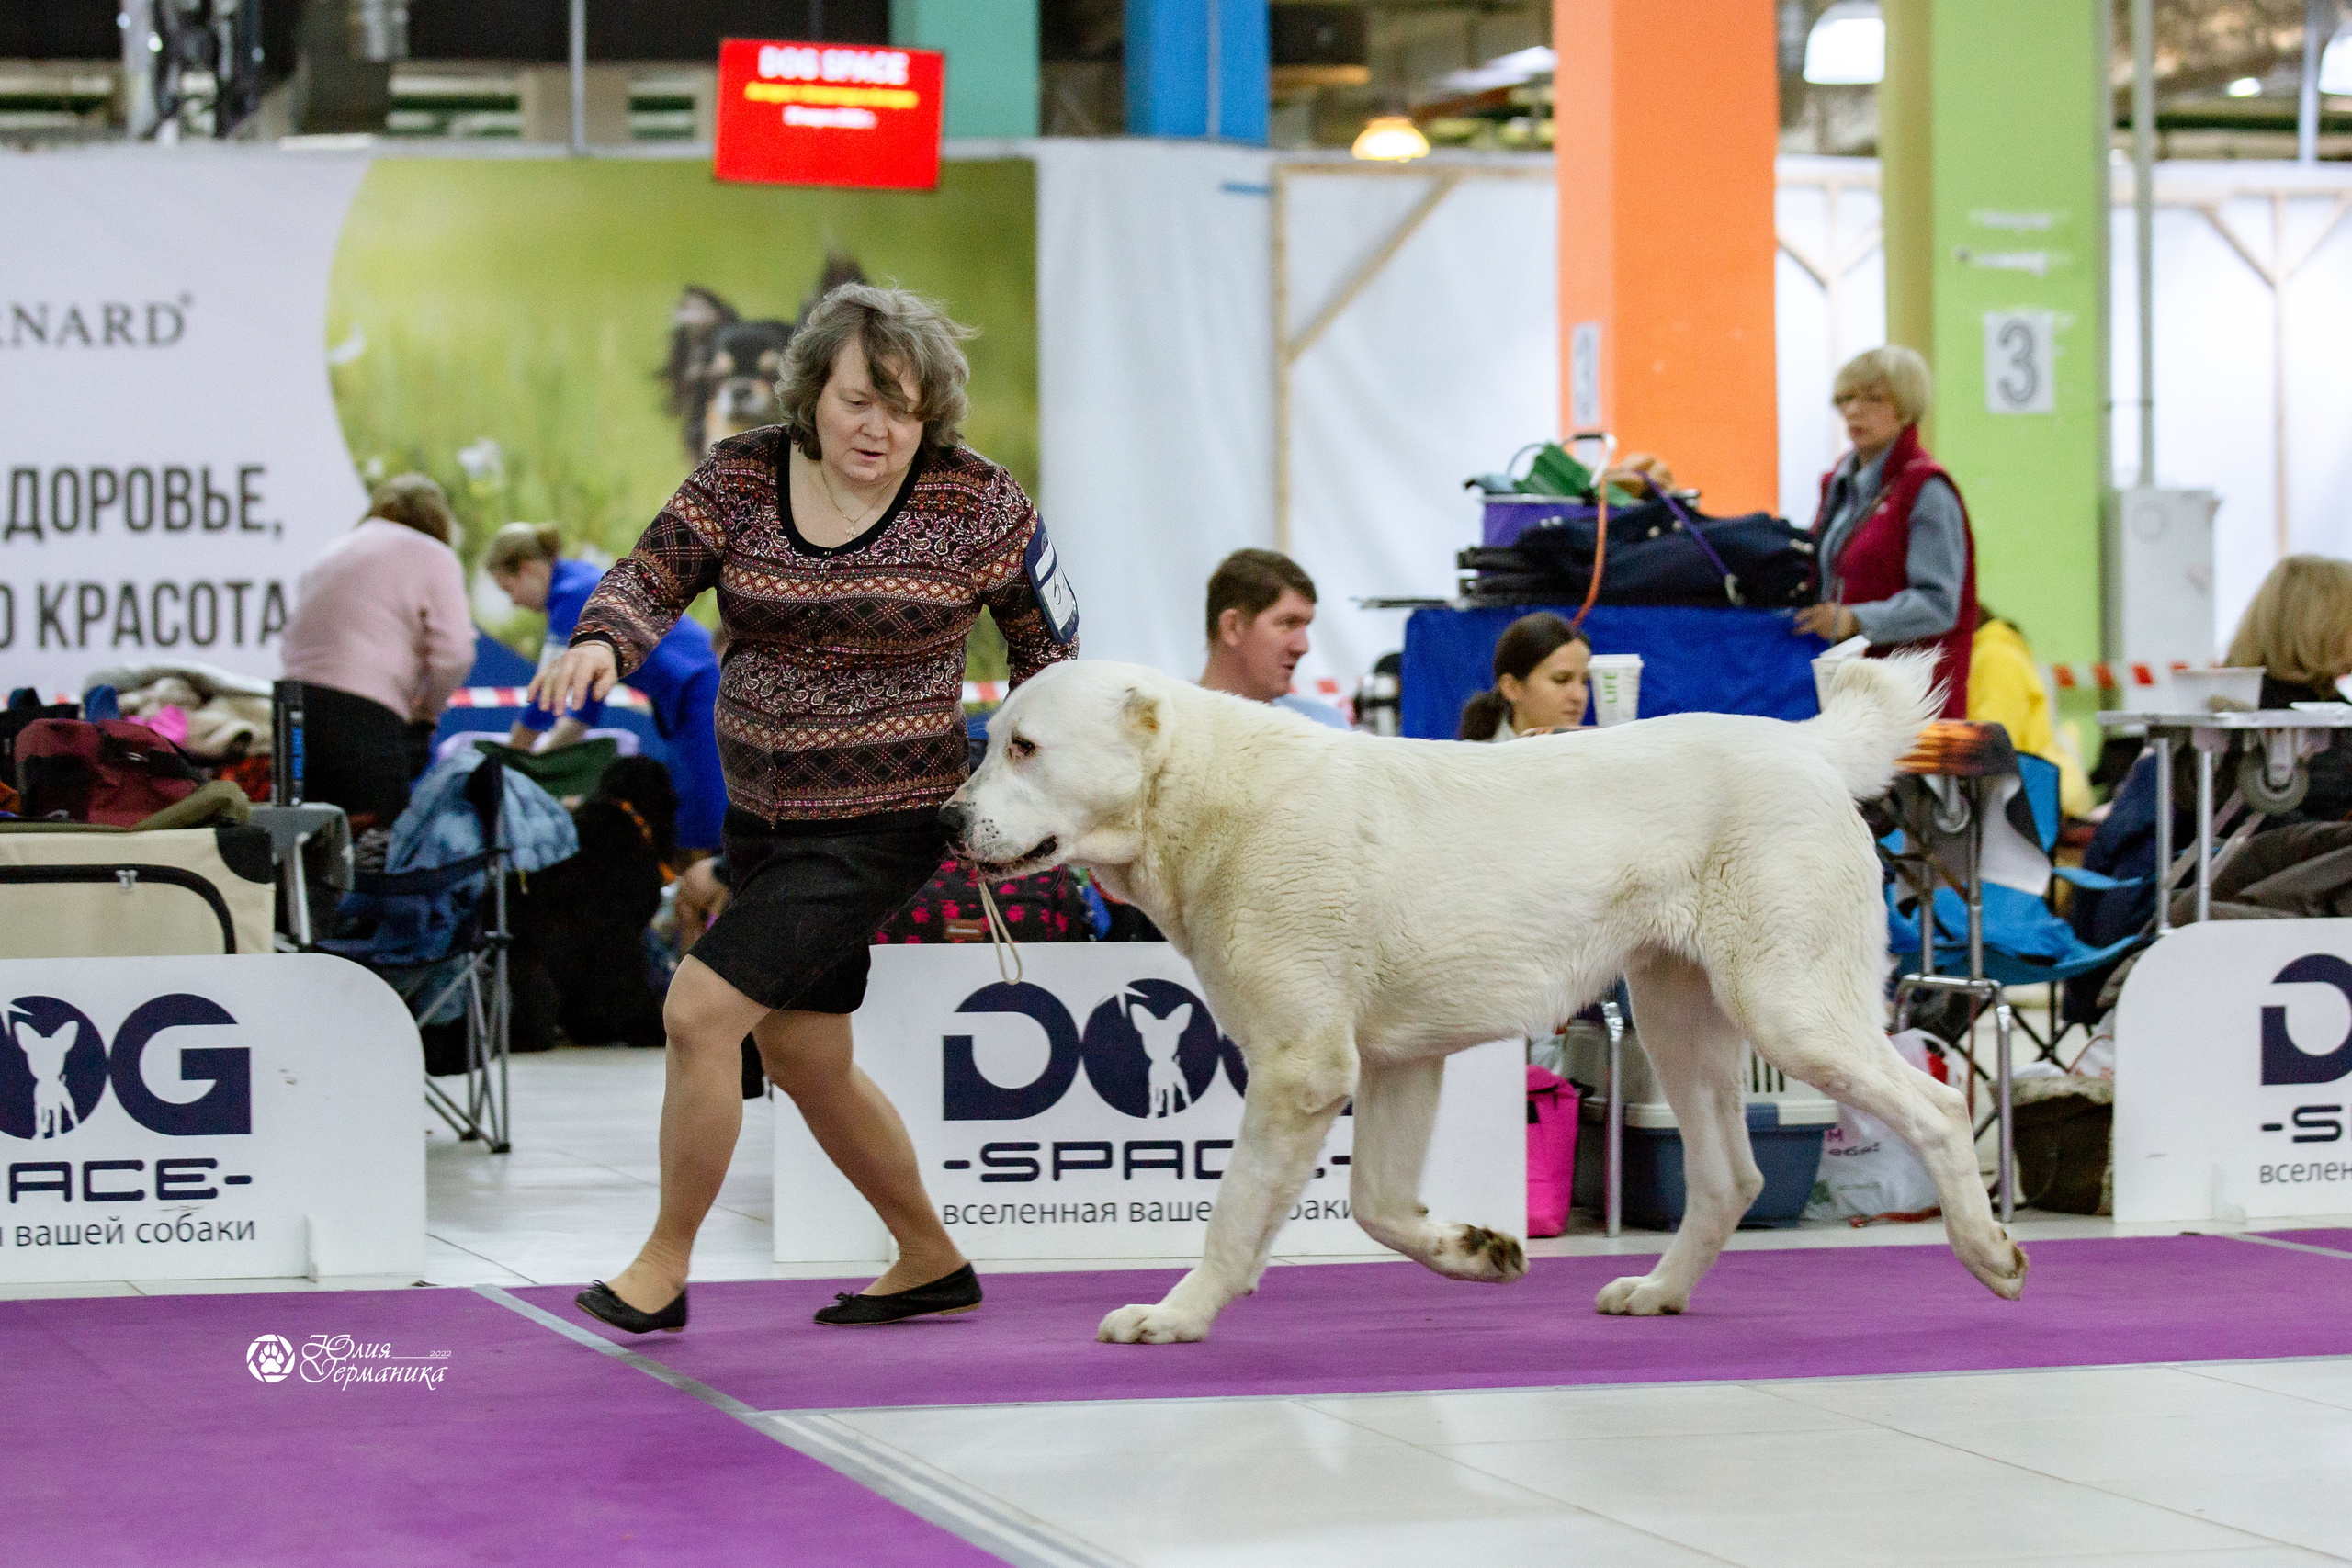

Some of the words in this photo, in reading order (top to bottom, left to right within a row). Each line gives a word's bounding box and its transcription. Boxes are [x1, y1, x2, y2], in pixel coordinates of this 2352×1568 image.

[0, 299, 185, 348] NARD
[1997, 318, 2041, 407] 3
[37, 581, 288, 648] КРАСОТА
[16, 1215, 125, 1247] вашей
[135, 1213, 256, 1244] собаки
[943, 1200, 1117, 1225] вселенная
[1130, 1198, 1211, 1224] ваше
